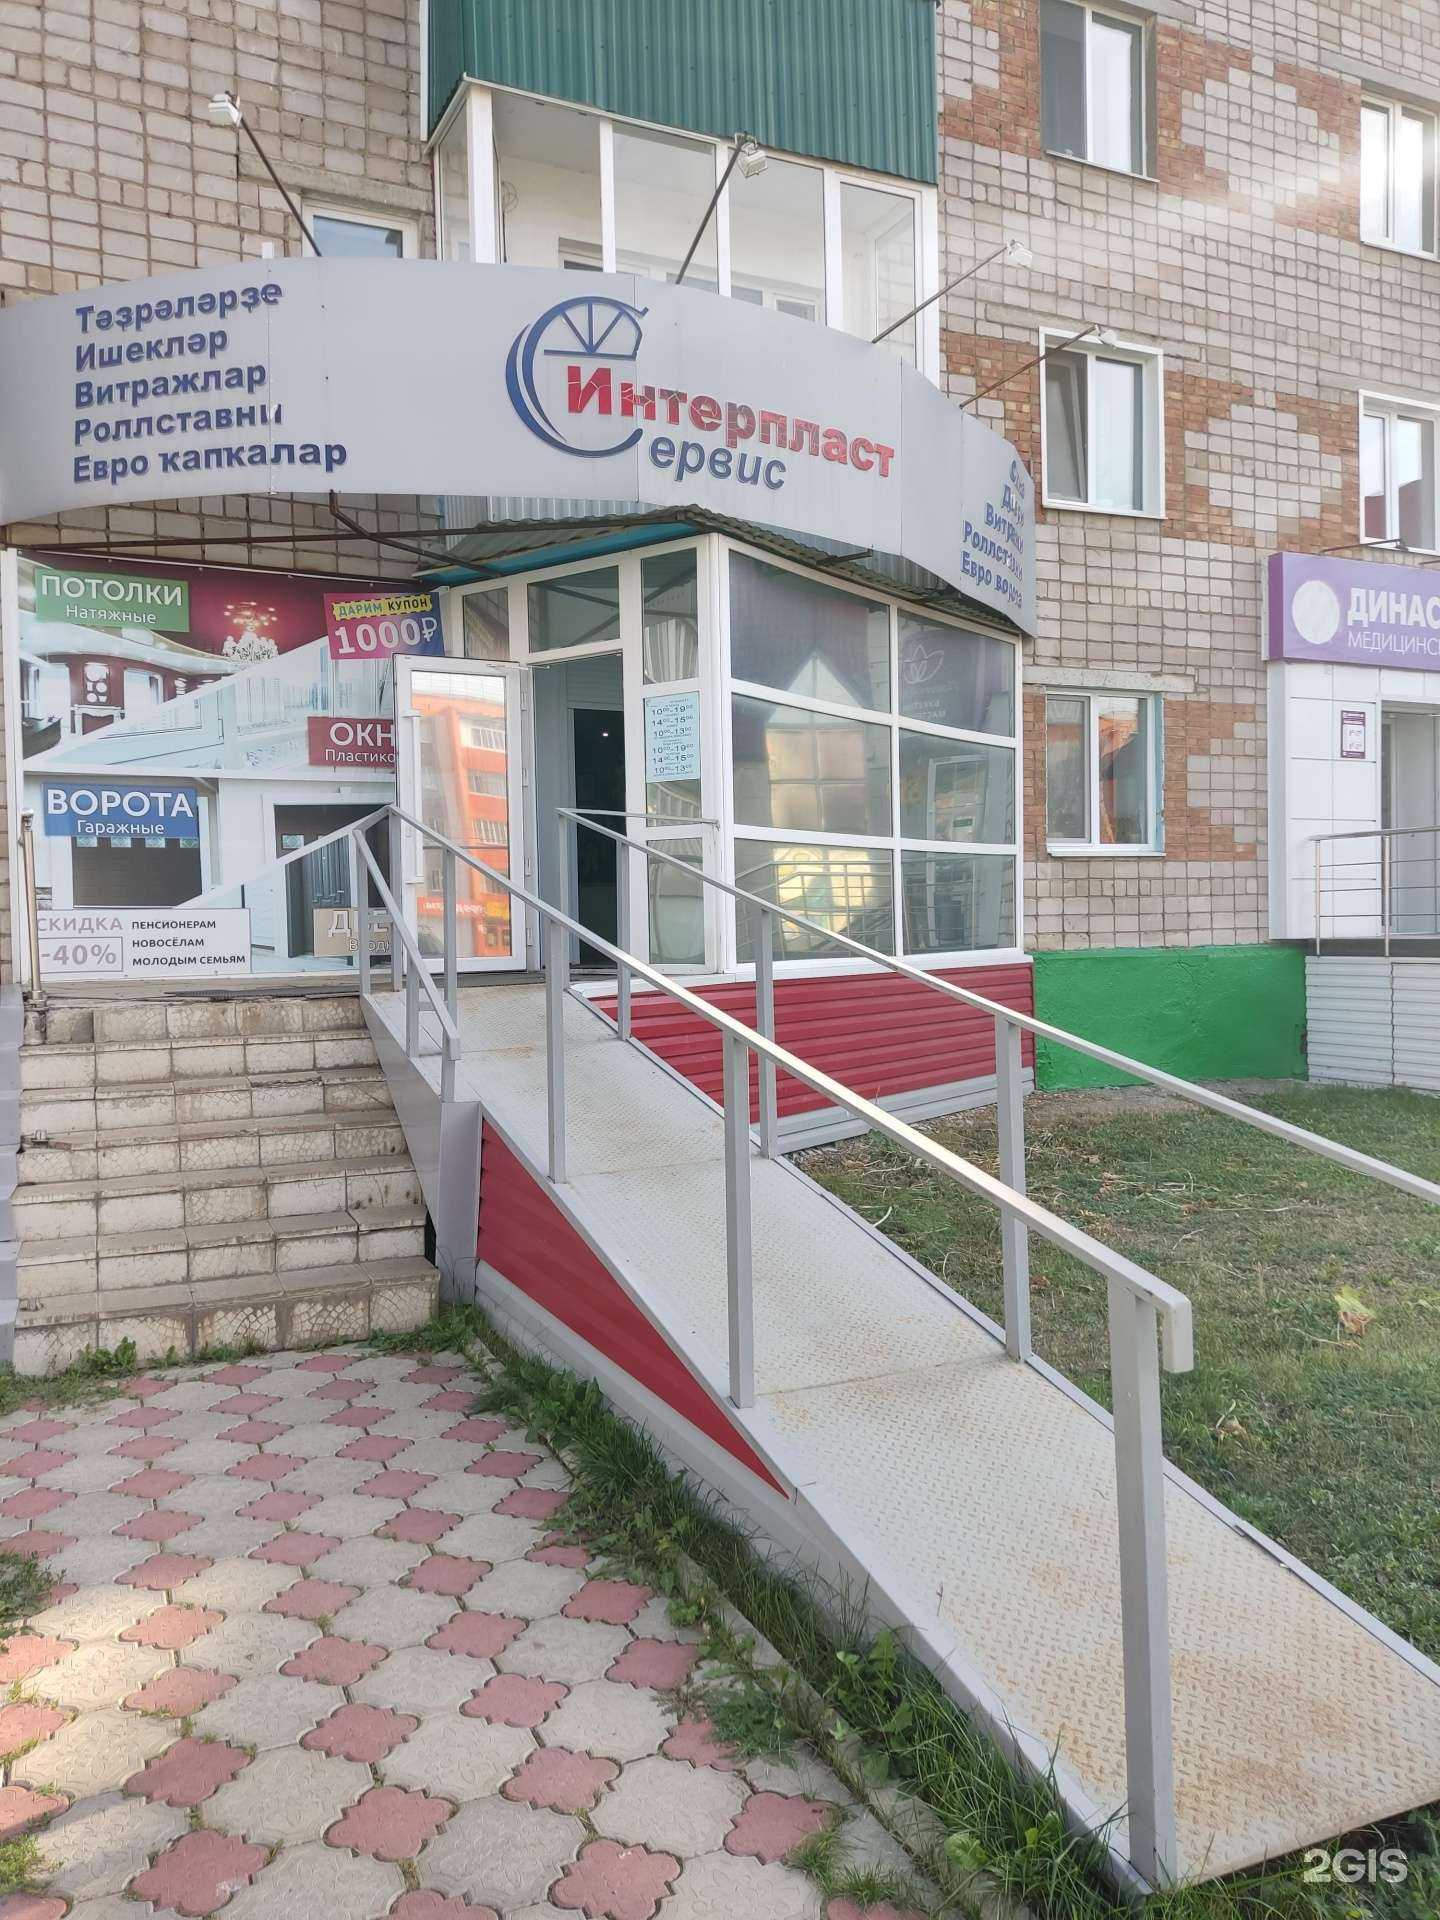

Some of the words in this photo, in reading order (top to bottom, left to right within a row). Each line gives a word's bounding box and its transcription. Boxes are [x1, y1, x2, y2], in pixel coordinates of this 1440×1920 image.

[76, 329, 228, 373] Ишекләр
[75, 364, 266, 409] Витражлар
[74, 404, 282, 447] Роллставни
[567, 365, 895, 477] Интерпласт
[74, 454, 148, 485] Евро
[961, 551, 992, 586] Евро
[41, 575, 182, 606] ПОТОЛКИ
[66, 604, 157, 624] Натяжные
[338, 604, 382, 617] ДАРИМ
[388, 598, 427, 611] КУПОН
[1347, 588, 1440, 629] ДИНАС
[1348, 631, 1440, 656] МЕДИЦИНС
[330, 722, 395, 746] ОКН
[48, 789, 193, 817] ВОРОТА
[77, 820, 165, 835] Гаражные
[37, 917, 123, 933] СКИДКА
[132, 921, 216, 930] ПЕНСИОНЕРАМ
[41, 944, 116, 965] -40%
[132, 937, 204, 948] НОВОСЁЛАМ
[132, 957, 197, 967] МОЛОДЫМ
[199, 955, 246, 965] СЕМЬЯМ
